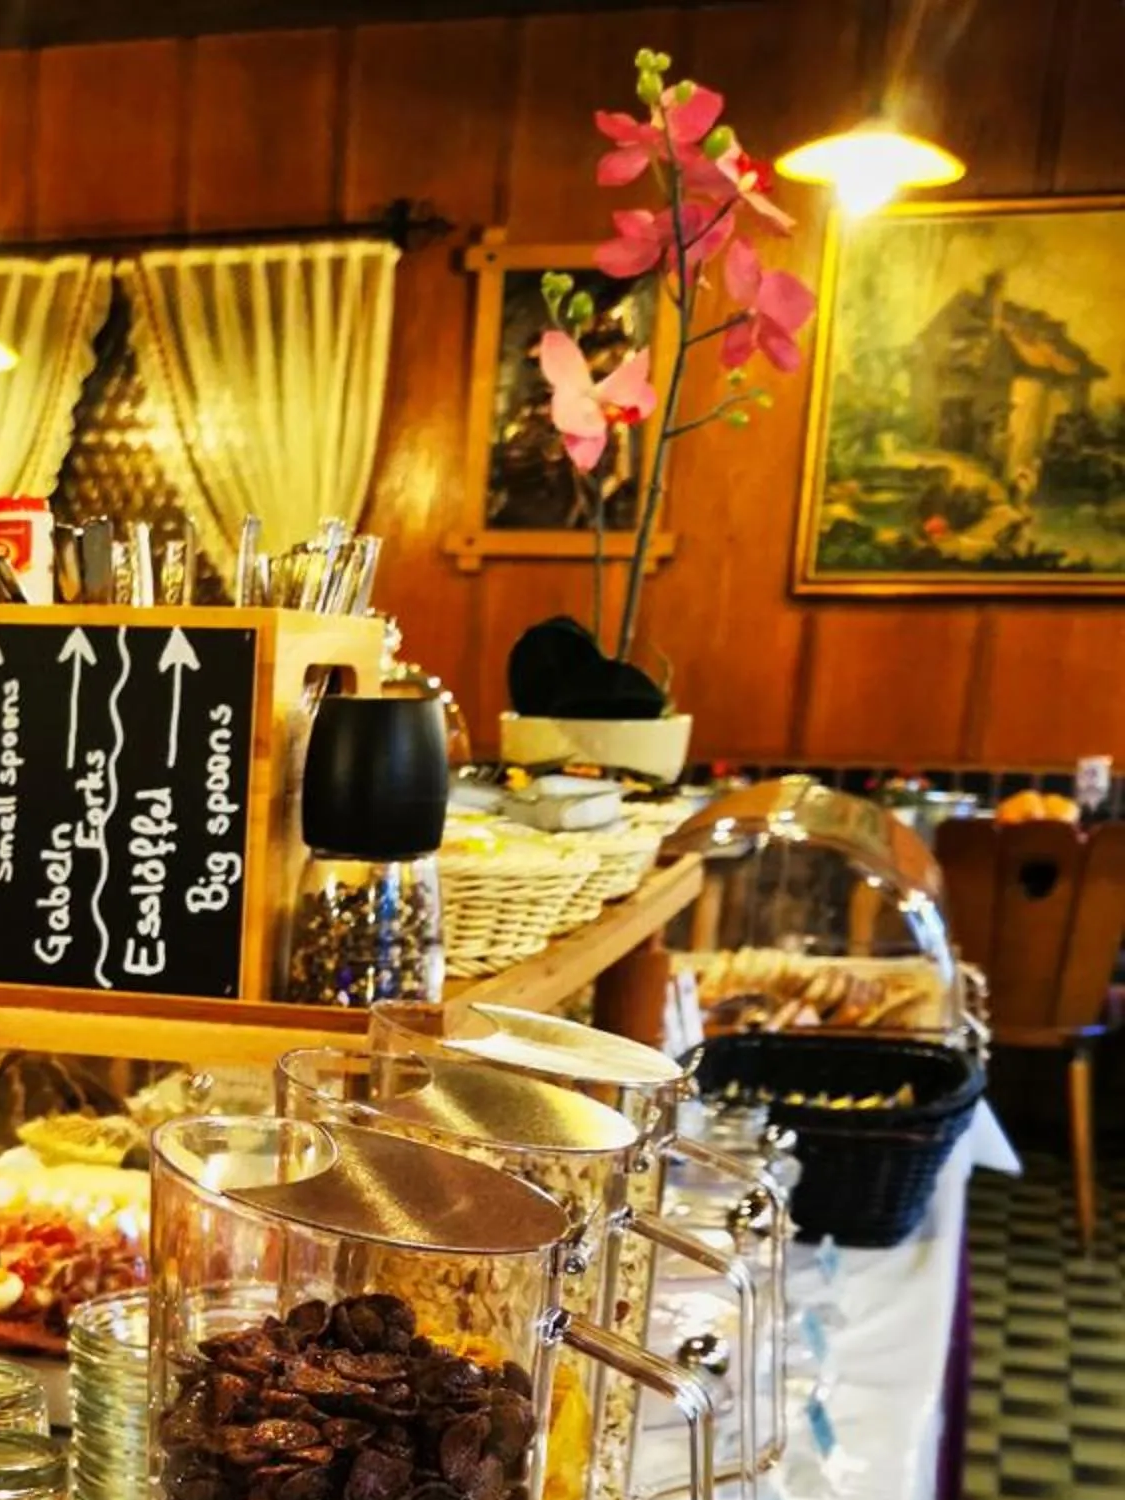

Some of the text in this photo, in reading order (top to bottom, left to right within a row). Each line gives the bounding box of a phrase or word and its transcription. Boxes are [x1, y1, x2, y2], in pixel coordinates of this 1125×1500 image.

[34, 822, 73, 964] Gabeln
[185, 704, 243, 913] Big spoons
